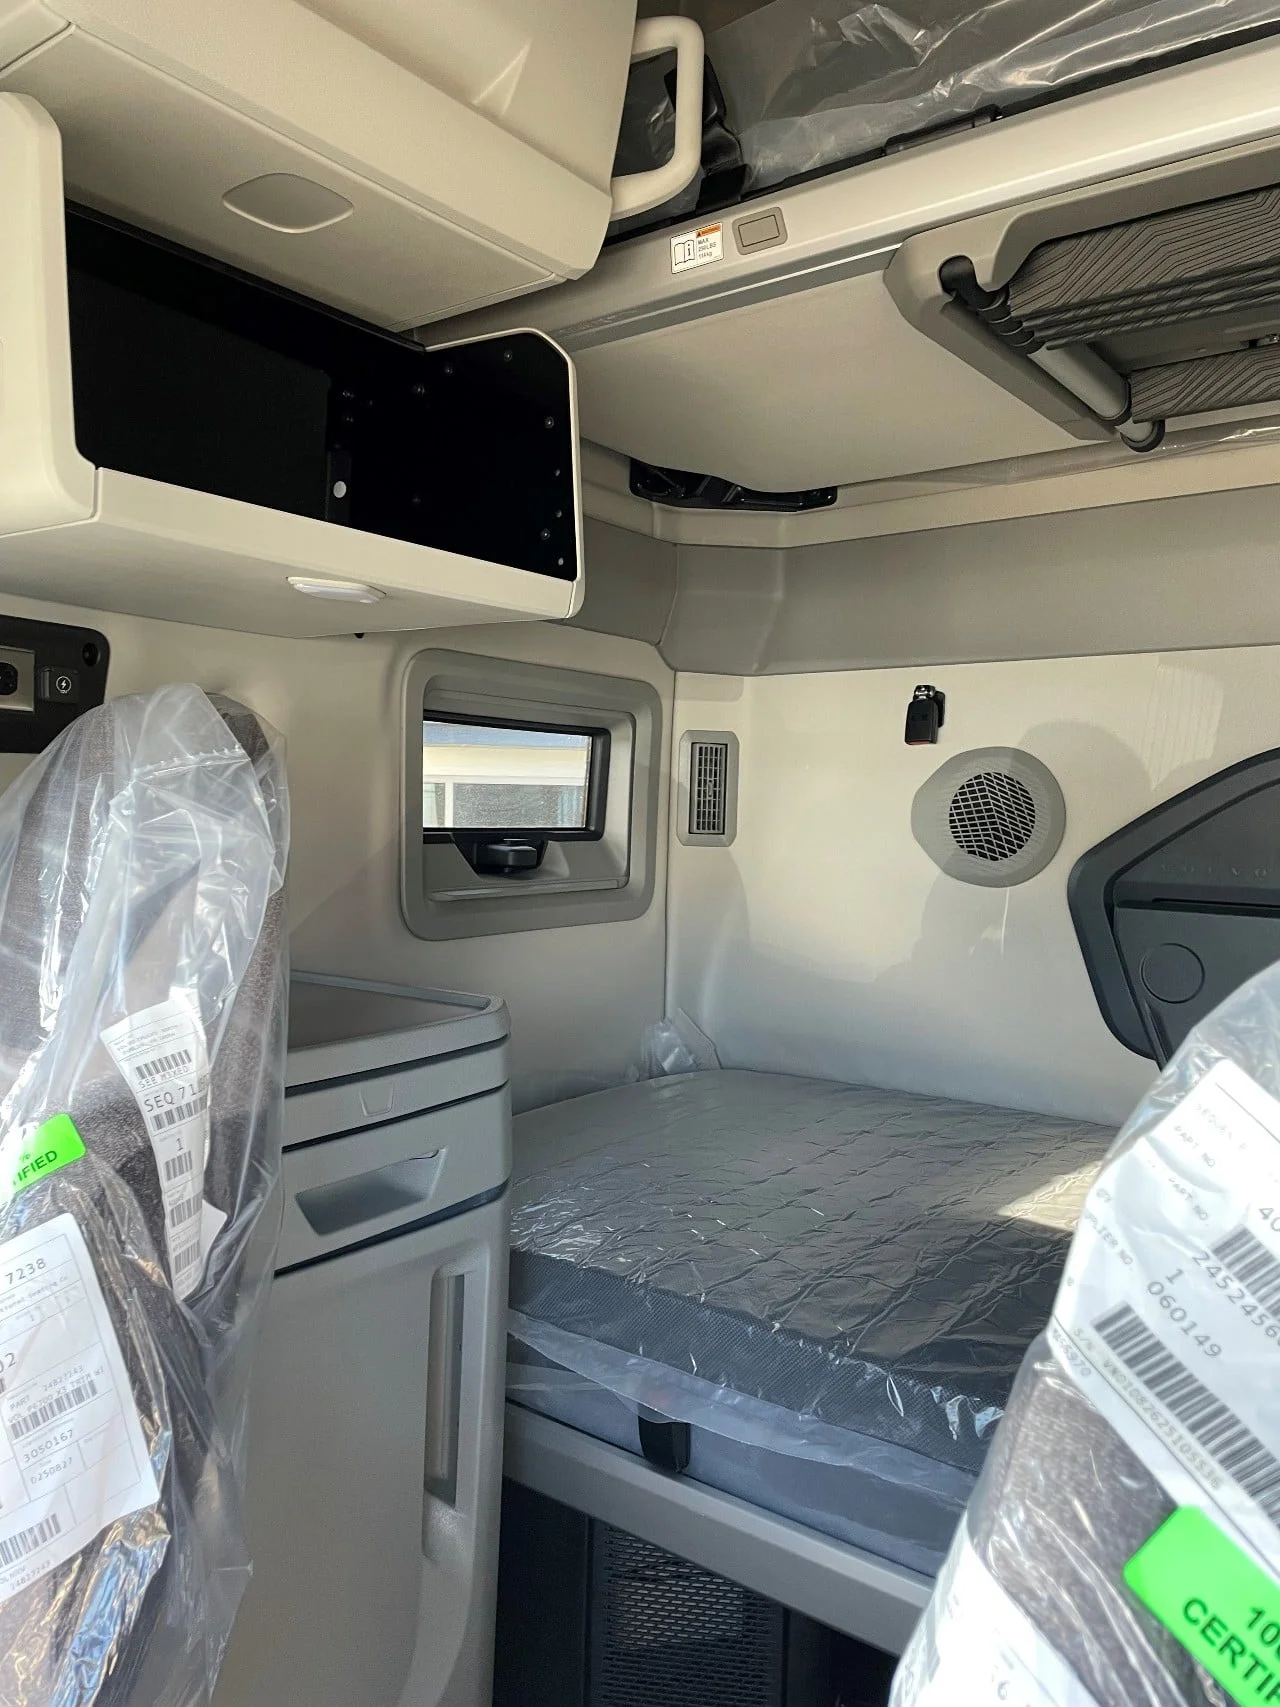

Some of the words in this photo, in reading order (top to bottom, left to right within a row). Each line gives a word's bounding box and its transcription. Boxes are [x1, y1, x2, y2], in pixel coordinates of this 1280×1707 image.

[144, 1091, 175, 1113] SEQ
[175, 1137, 184, 1152] 1
[12, 1150, 58, 1186] IFIED
[4, 1257, 47, 1285] 7238
[1165, 1268, 1185, 1285] 1
[1146, 1280, 1223, 1358] 060149
[23, 1429, 74, 1464] 3050167
